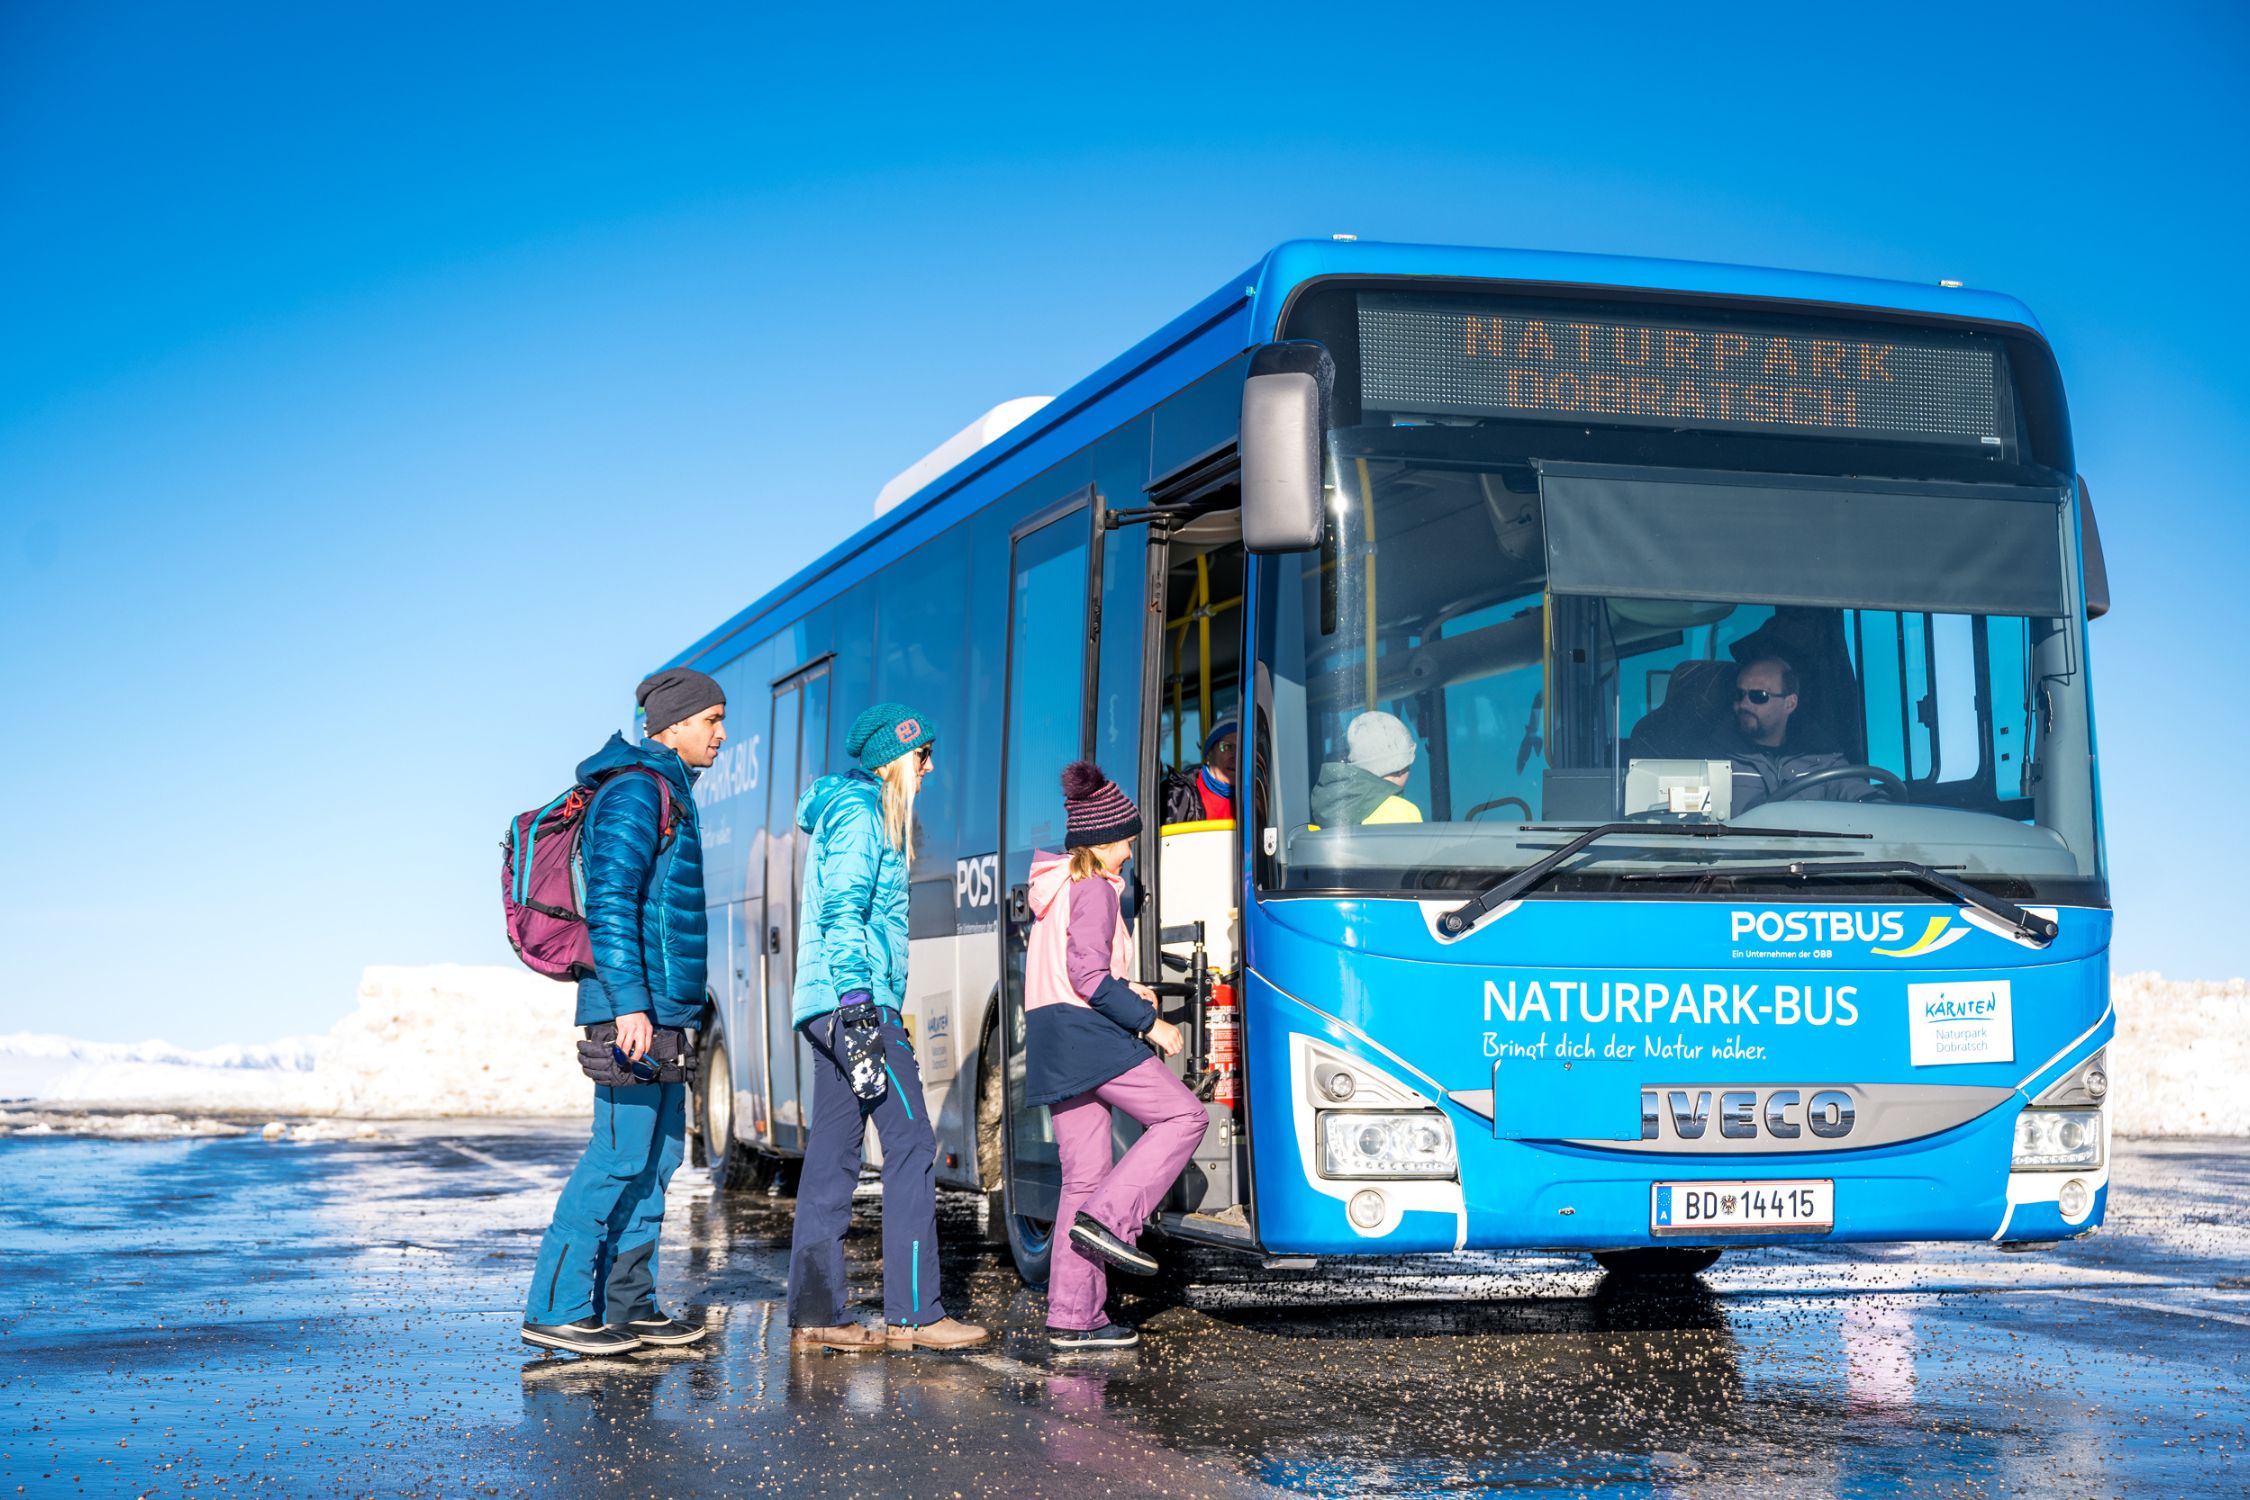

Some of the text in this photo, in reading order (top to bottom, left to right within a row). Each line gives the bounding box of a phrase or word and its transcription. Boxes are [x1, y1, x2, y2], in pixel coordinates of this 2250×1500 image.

[1466, 314, 1895, 382] NATURPARK
[1507, 368, 1857, 428] DOBRATSCH
[1731, 911, 1905, 943] POSTBUS
[1732, 949, 1744, 959] Ein
[1745, 949, 1797, 959] Unternehmen
[1798, 949, 1811, 959] der
[1483, 980, 1859, 1027] NATURPARK-BUS
[1925, 991, 1996, 1018] KÄRNTEN
[1482, 1031, 1767, 1061] Bringt dich der Natur näher.
[1936, 1026, 1987, 1041] Naturpark
[1936, 1040, 1988, 1053] Dobratsch
[1641, 1089, 1856, 1140] IVECO
[1660, 1210, 1668, 1220] A
[1685, 1190, 1815, 1220] BD 14415
